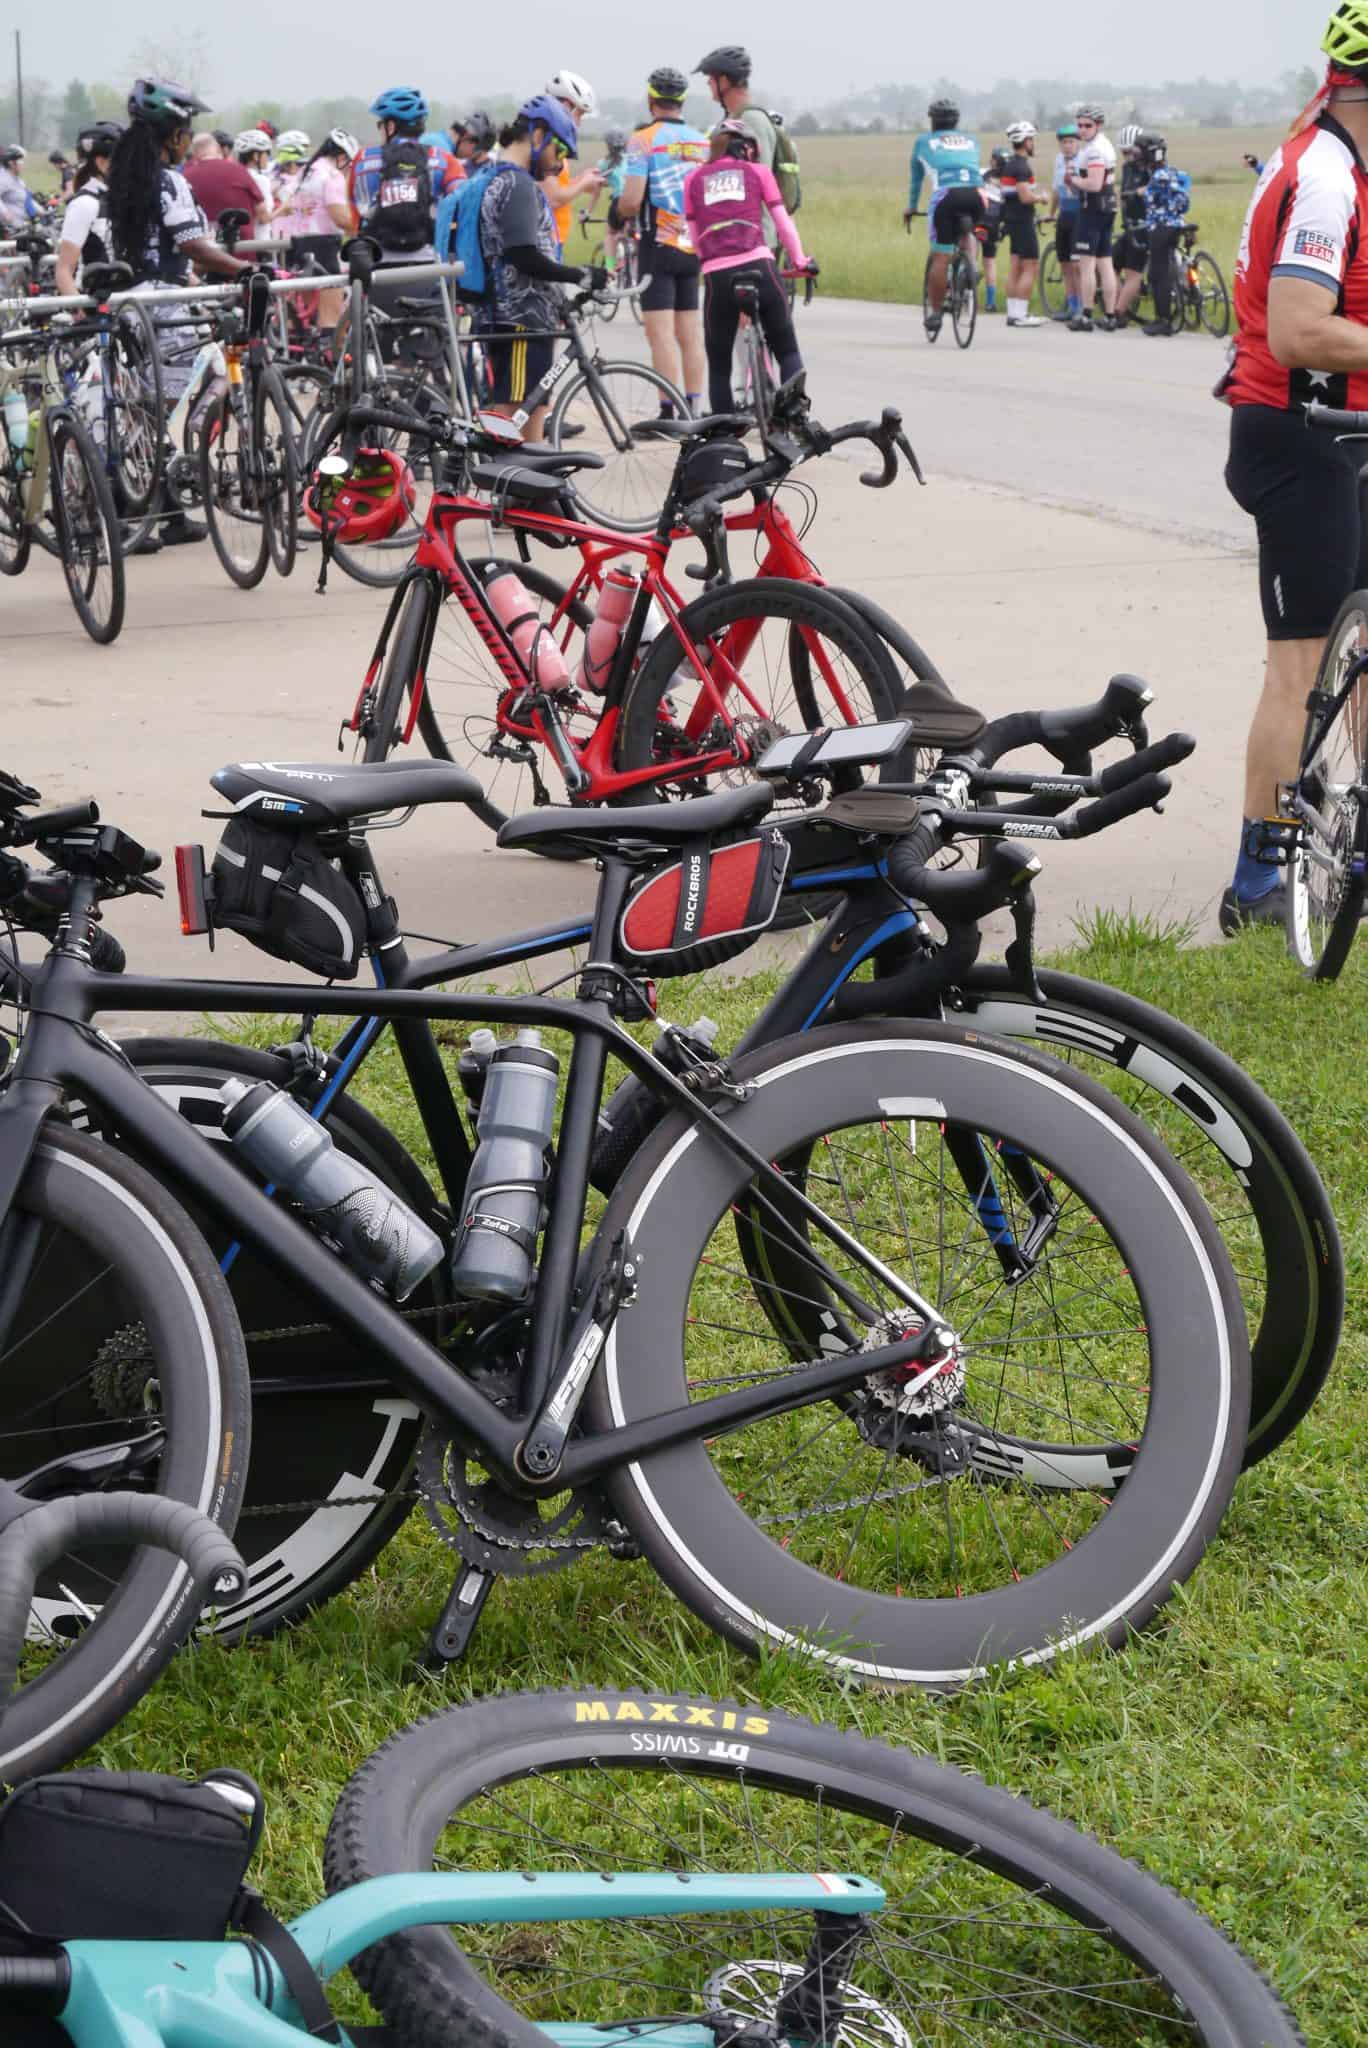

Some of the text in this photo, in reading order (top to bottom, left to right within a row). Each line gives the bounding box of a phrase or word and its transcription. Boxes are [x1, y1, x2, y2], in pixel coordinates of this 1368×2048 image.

[384, 183, 418, 202] 1156
[1305, 244, 1332, 261] TEAM
[1002, 822, 1057, 835] PROFILE
[683, 854, 702, 933] ROCKBROS
[575, 1701, 770, 1736] MAXXIS
[630, 1732, 751, 1762] DT SWISS
